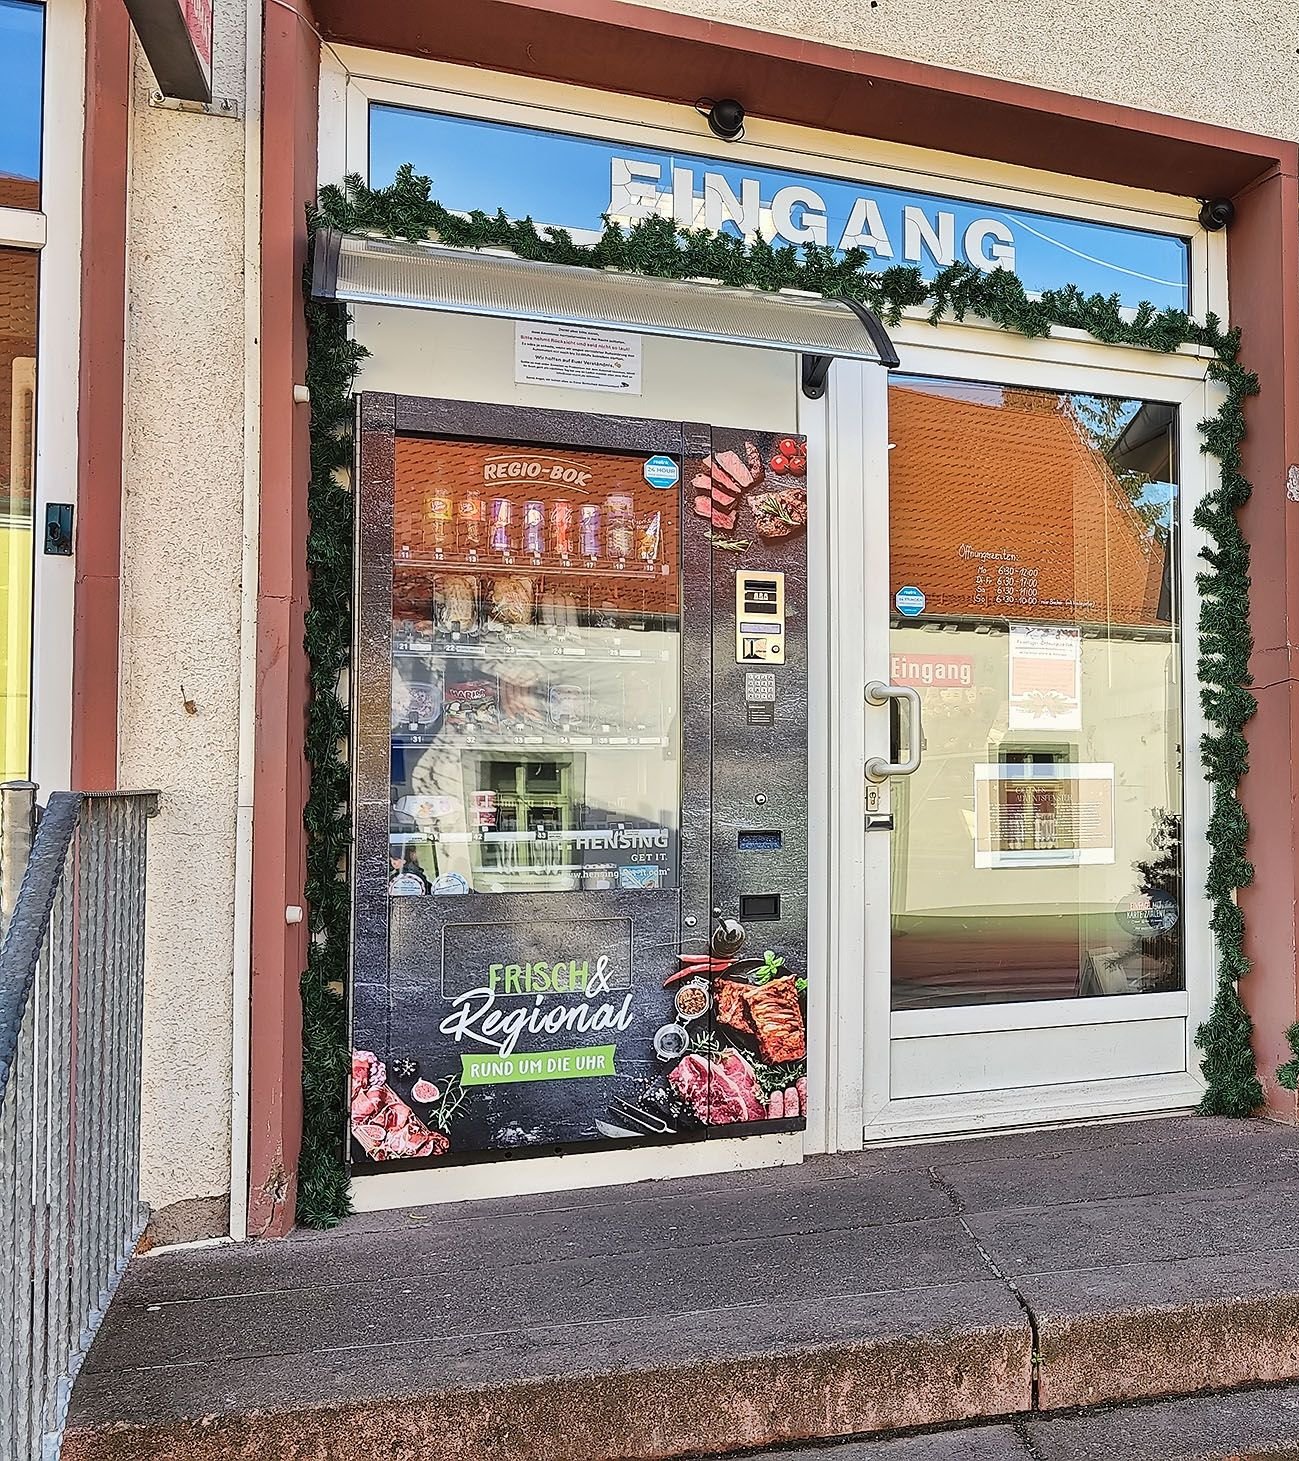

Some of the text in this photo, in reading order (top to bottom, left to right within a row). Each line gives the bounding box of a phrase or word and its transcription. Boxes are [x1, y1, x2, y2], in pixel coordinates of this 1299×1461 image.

[611, 157, 1016, 273] EINGANG
[891, 656, 971, 684] Eingang
[576, 833, 669, 850] HENSING
[631, 853, 668, 862] GET IT.
[439, 986, 634, 1058] Regional
[470, 1055, 605, 1079] RUND UM DIE UHR
